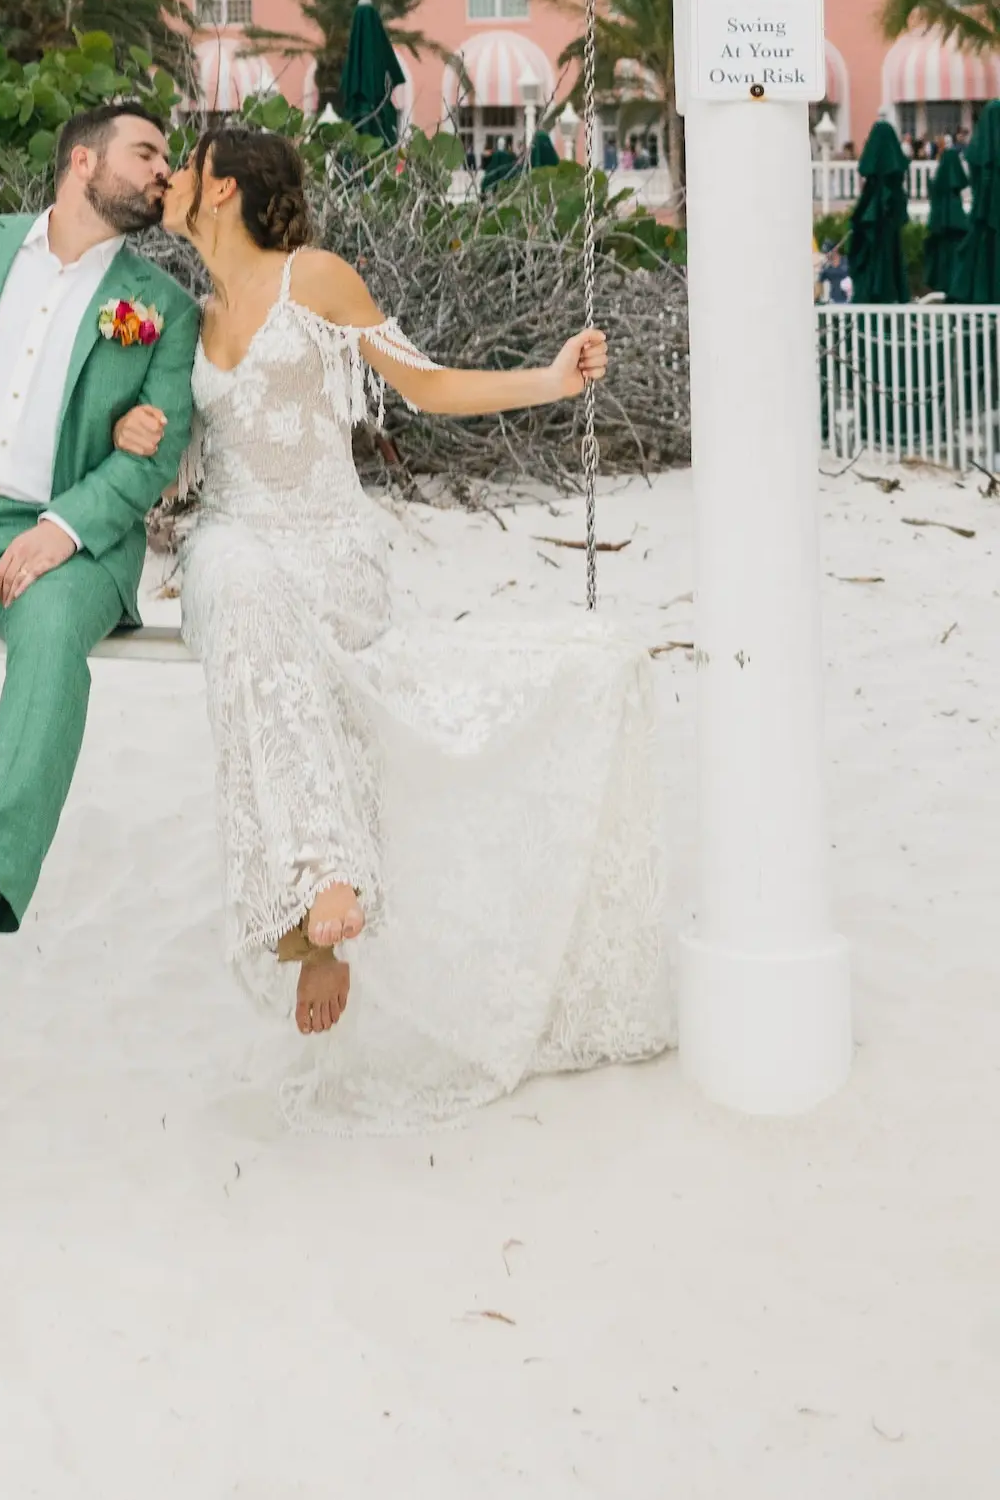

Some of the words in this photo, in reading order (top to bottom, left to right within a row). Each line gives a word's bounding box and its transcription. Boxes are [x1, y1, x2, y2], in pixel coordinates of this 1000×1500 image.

[727, 17, 786, 37] Swing
[720, 43, 741, 59] At
[749, 42, 795, 59] Your
[709, 68, 755, 84] Own
[763, 68, 806, 84] Risk
